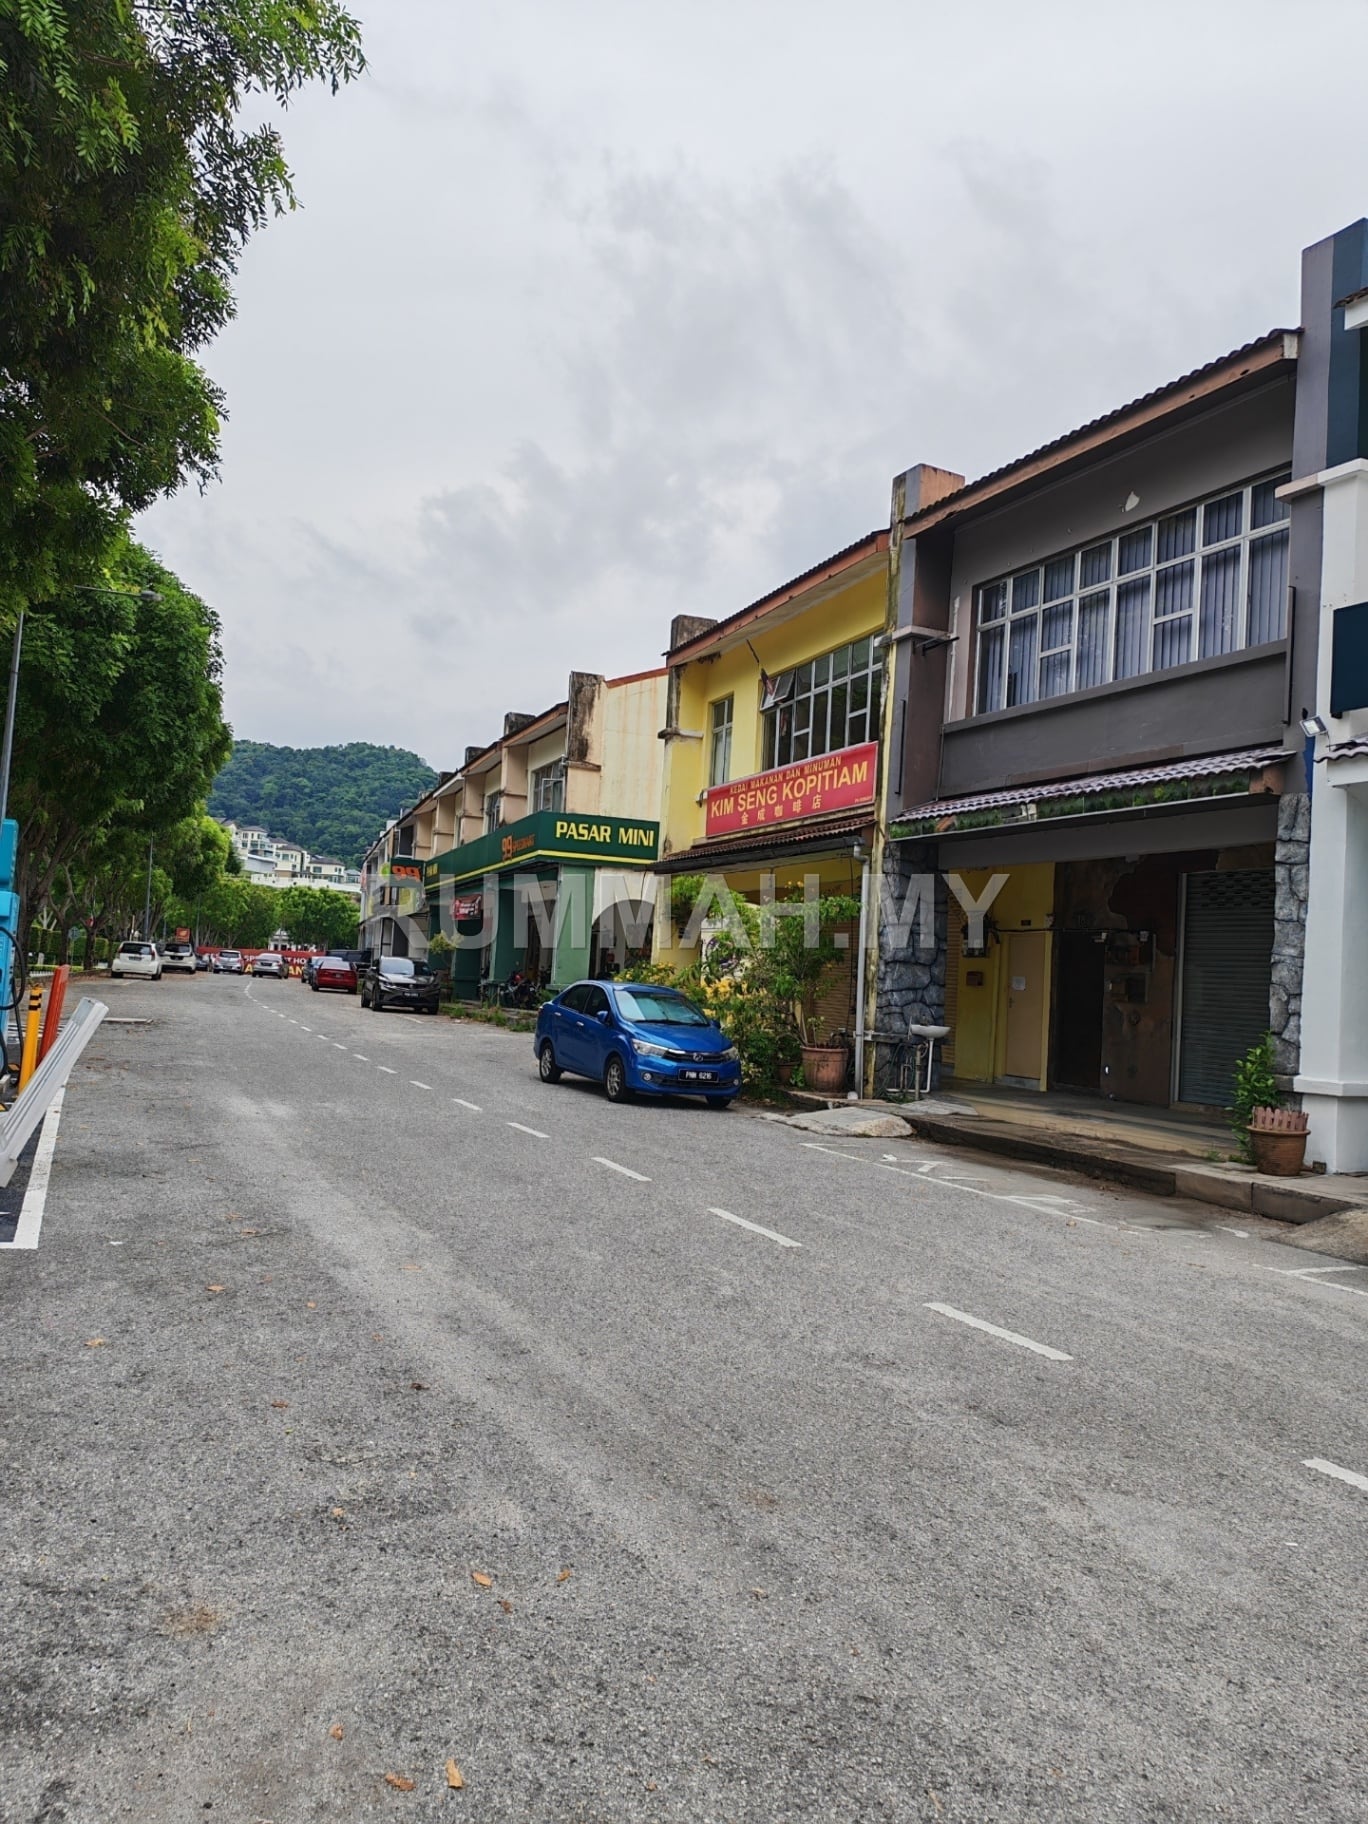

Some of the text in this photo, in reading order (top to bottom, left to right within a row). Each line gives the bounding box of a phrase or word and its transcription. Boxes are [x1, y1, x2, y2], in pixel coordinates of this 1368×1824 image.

[750, 772, 783, 790] MAKANAN
[786, 767, 801, 780] DAN
[804, 756, 842, 775] MINUMAN
[711, 798, 734, 818] KIM
[737, 786, 777, 812] SENG
[782, 760, 868, 801] KOPITIAM
[555, 820, 611, 843] PASAR
[618, 826, 655, 848] MINI
[392, 866, 421, 882] 99
